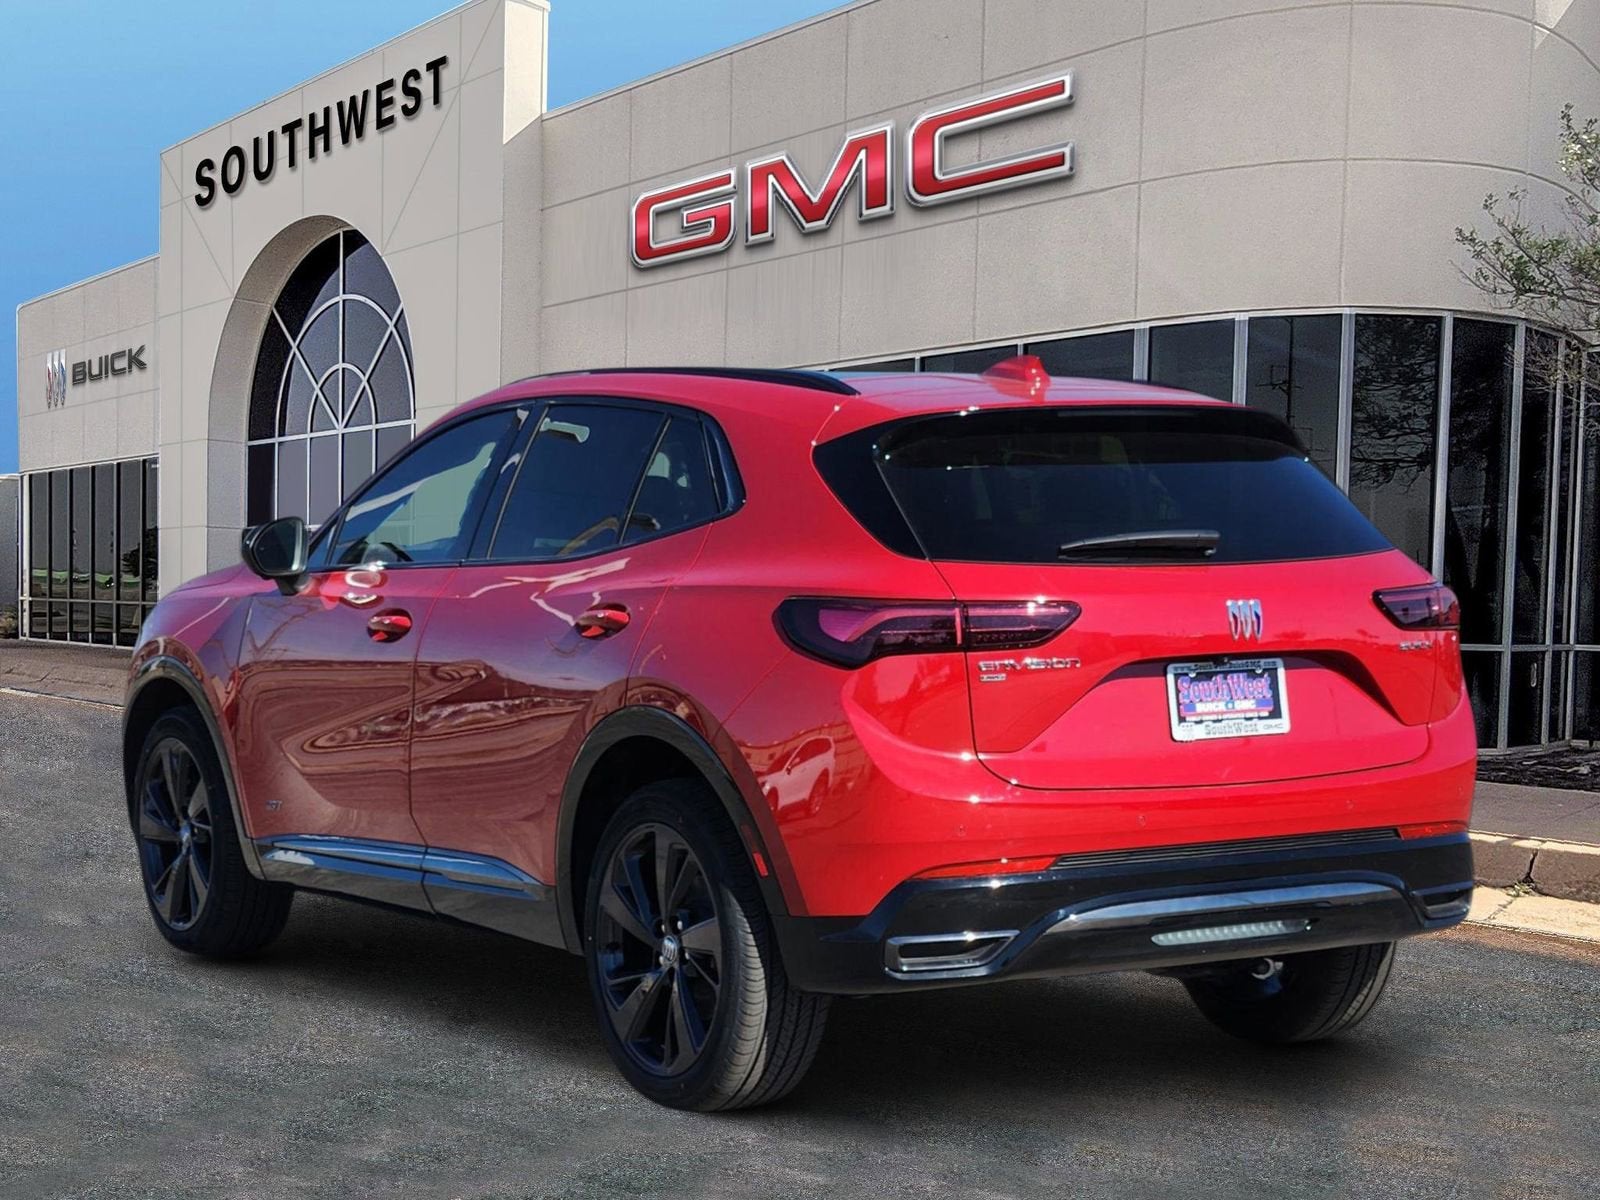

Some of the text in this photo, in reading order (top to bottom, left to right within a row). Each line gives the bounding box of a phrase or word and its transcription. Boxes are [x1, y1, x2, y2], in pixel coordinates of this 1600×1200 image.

[195, 55, 447, 207] SOUTHWEST
[630, 69, 1075, 268] GMC
[72, 345, 147, 386] BUICK
